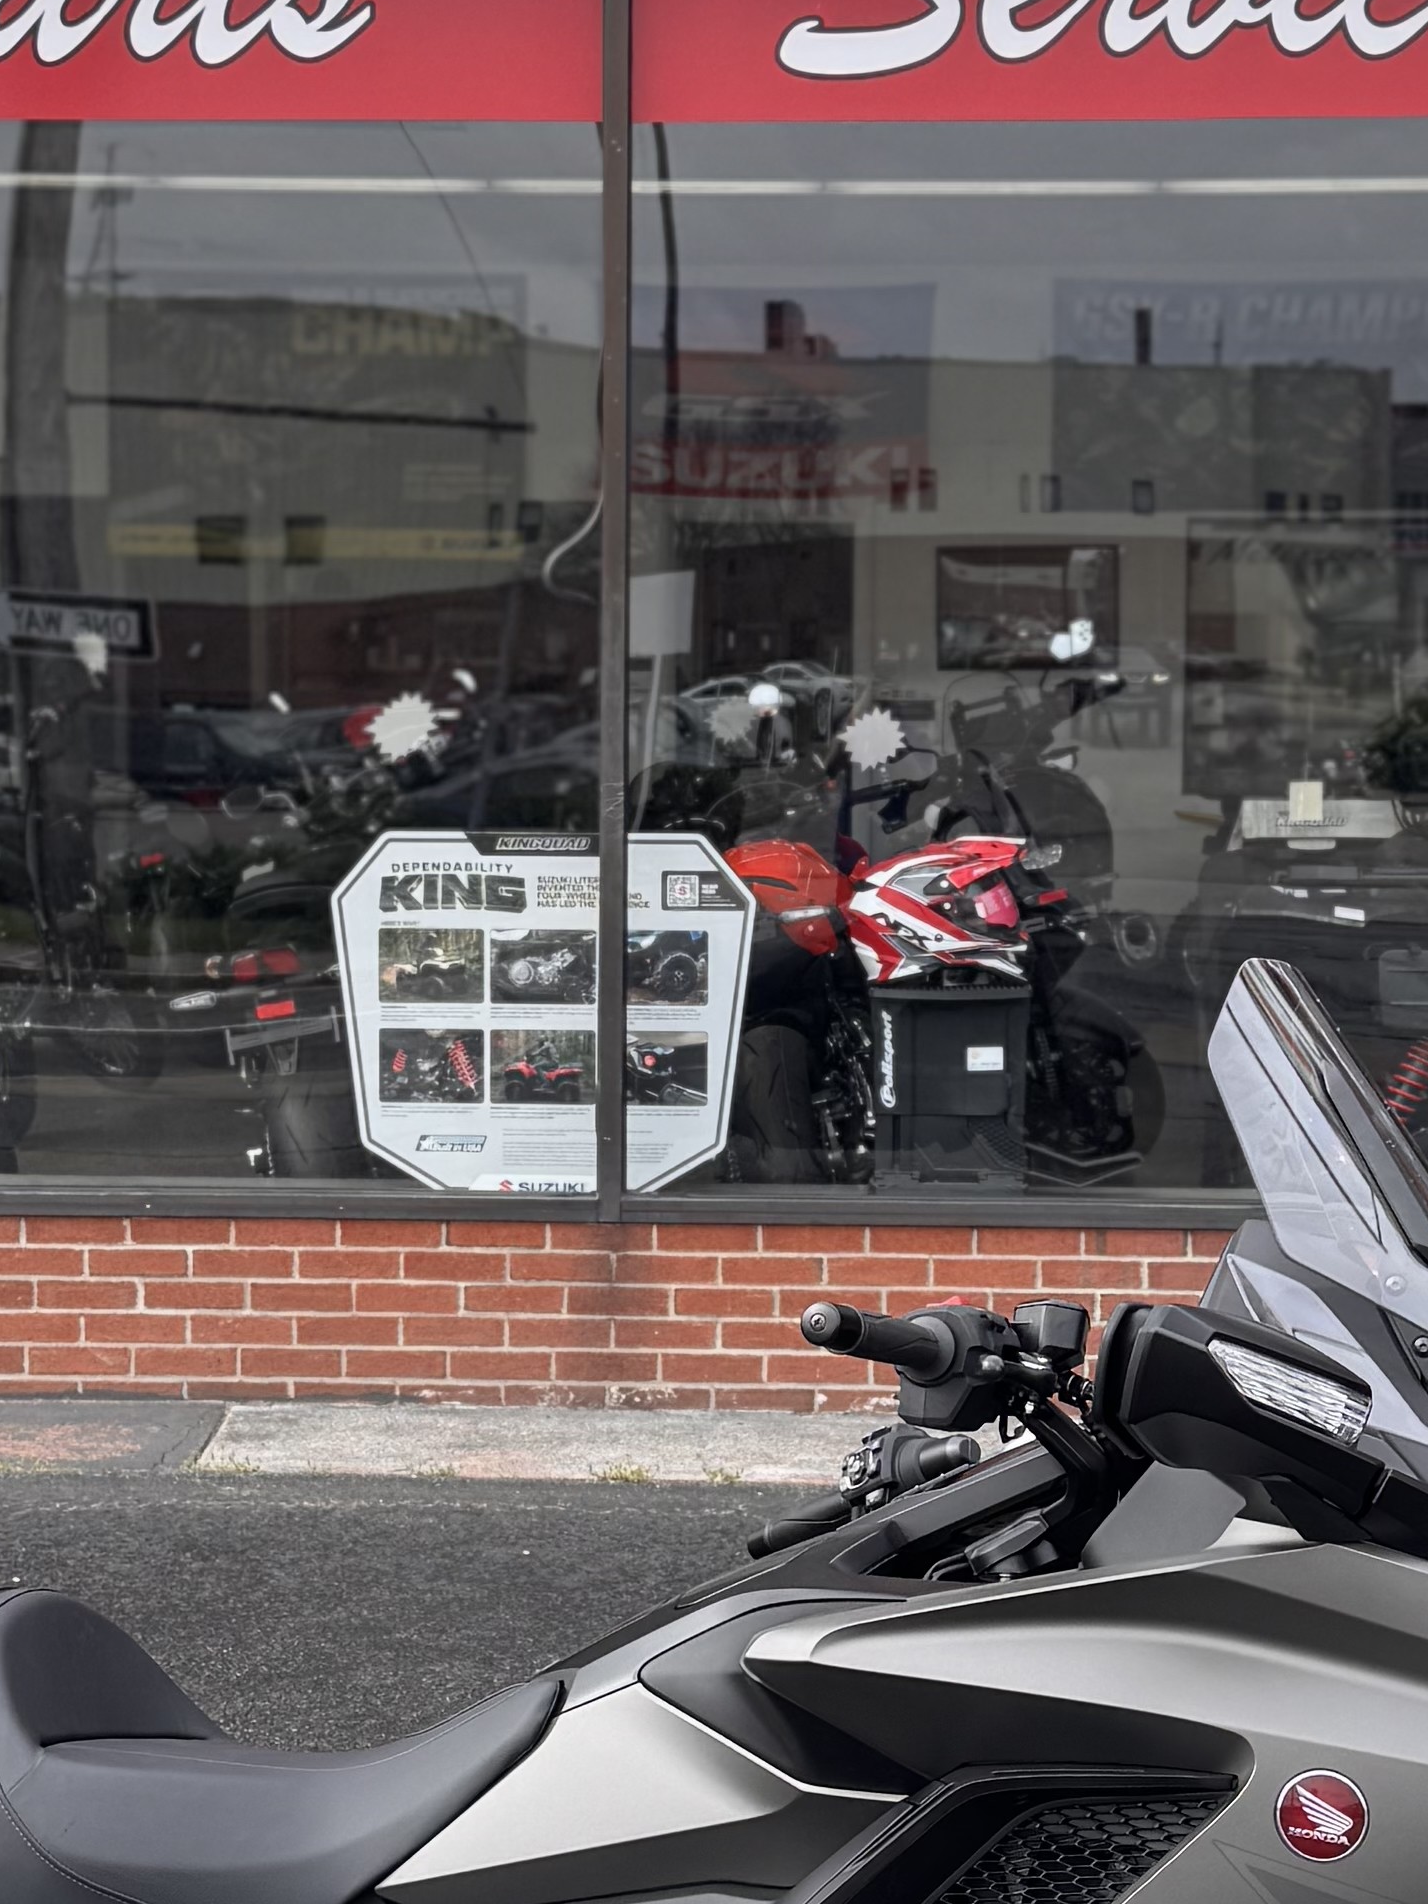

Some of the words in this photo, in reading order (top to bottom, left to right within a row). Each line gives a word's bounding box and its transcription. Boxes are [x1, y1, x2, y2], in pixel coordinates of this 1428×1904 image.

[630, 443, 909, 493] SUZUKI
[495, 837, 591, 851] KINGQUAD
[391, 863, 514, 874] DEPENDABILITY
[379, 873, 527, 914] KING
[880, 1009, 897, 1109] Polisport
[517, 1182, 586, 1193] SUZUKI
[1287, 1826, 1351, 1847] HONDA
